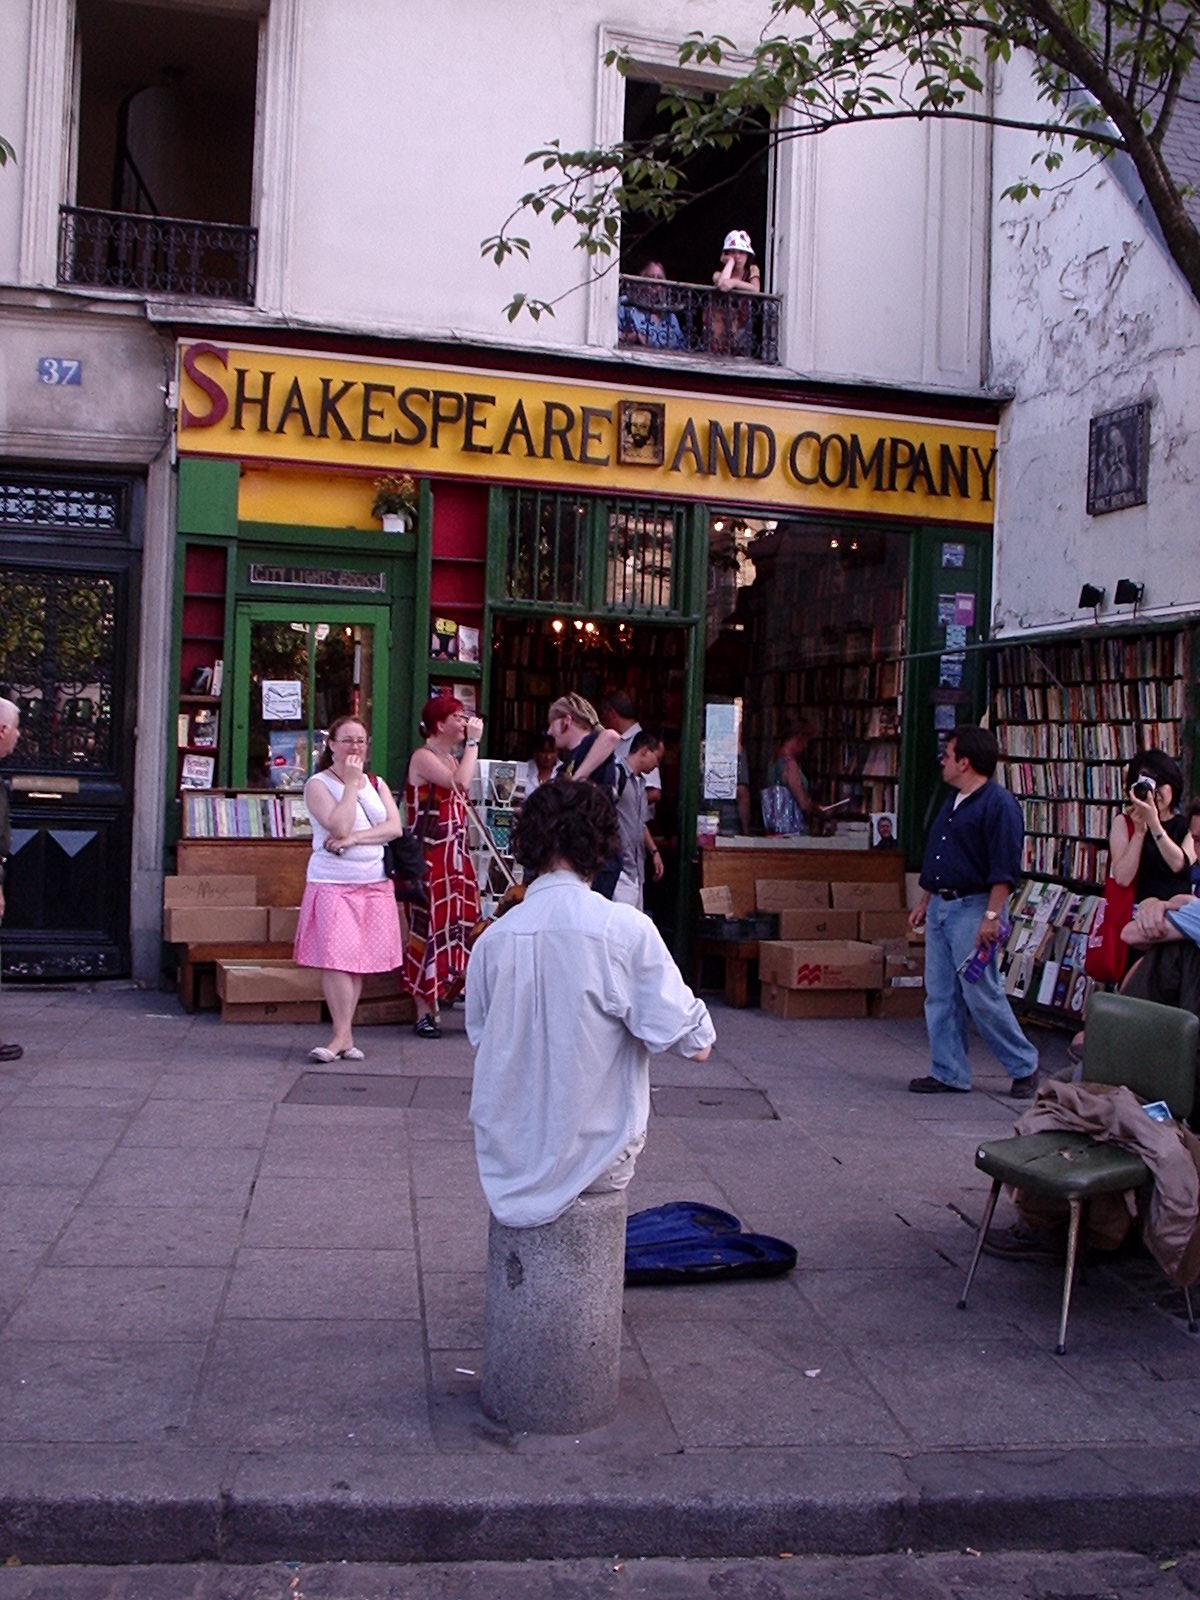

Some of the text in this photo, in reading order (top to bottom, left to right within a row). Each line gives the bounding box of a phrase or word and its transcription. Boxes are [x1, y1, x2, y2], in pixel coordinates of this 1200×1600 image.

[43, 359, 79, 385] 37
[181, 342, 999, 502] SHAKESPEARE AND COMPANY
[255, 567, 285, 582] CITY
[292, 569, 335, 585] LIGHTS
